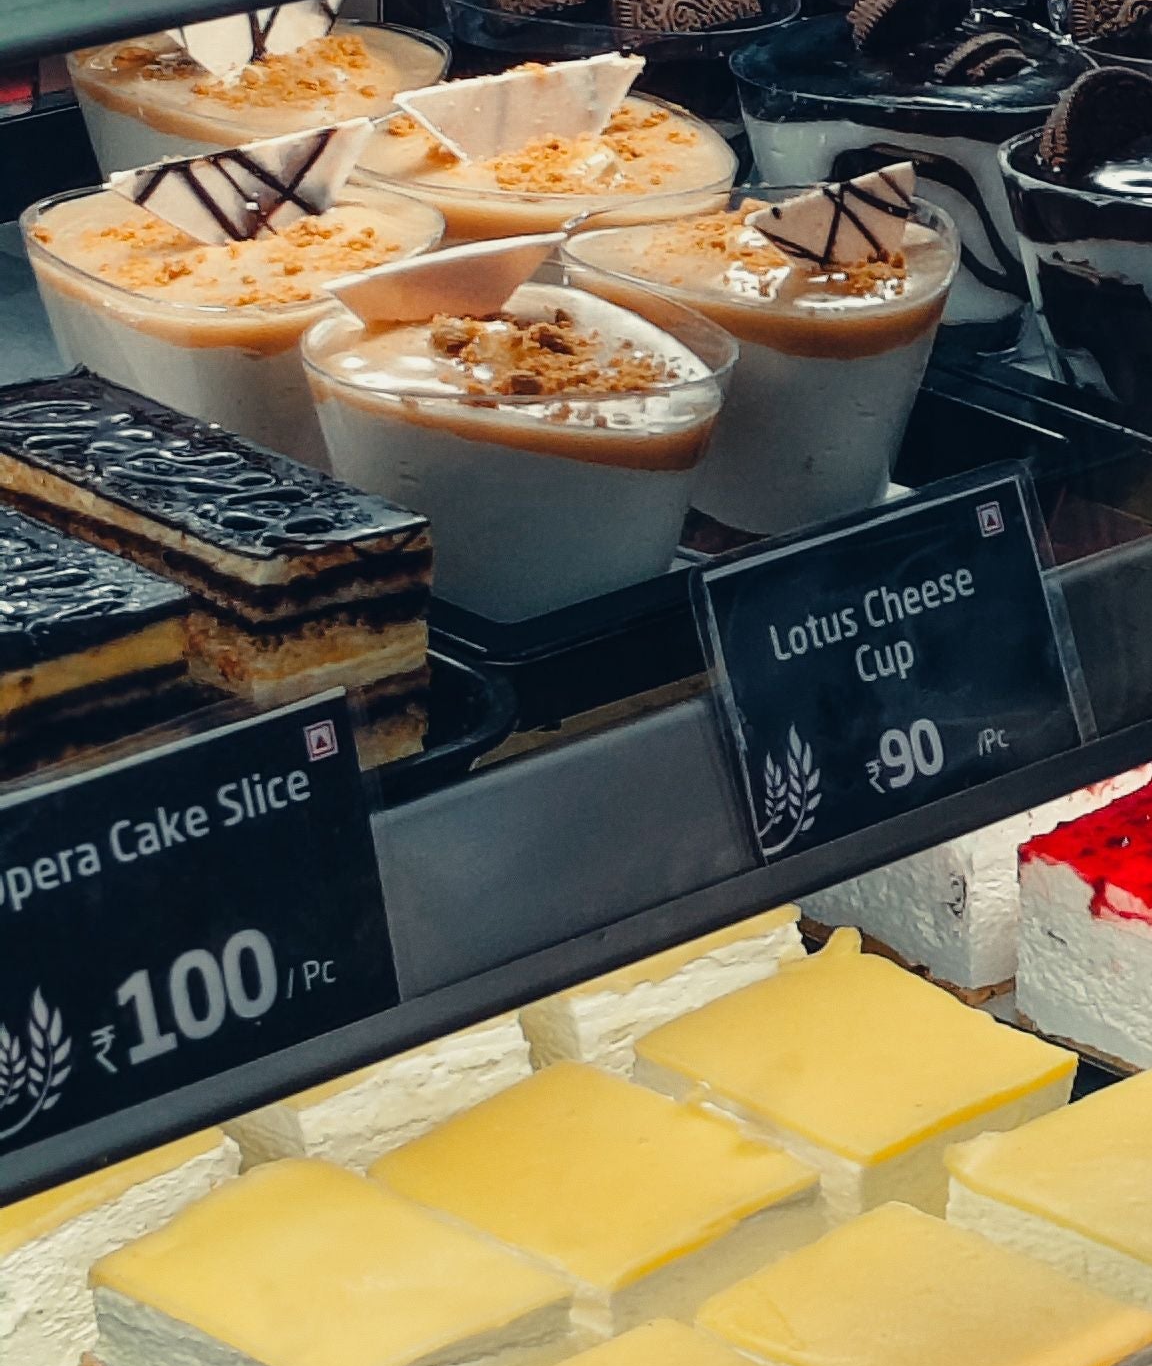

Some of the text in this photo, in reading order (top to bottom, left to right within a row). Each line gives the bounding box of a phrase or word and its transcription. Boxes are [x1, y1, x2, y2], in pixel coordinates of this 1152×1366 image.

[769, 568, 975, 662] Lotus Cheese
[855, 639, 914, 682] Cup
[110, 804, 210, 864] Cake
[217, 770, 312, 827] Slice
